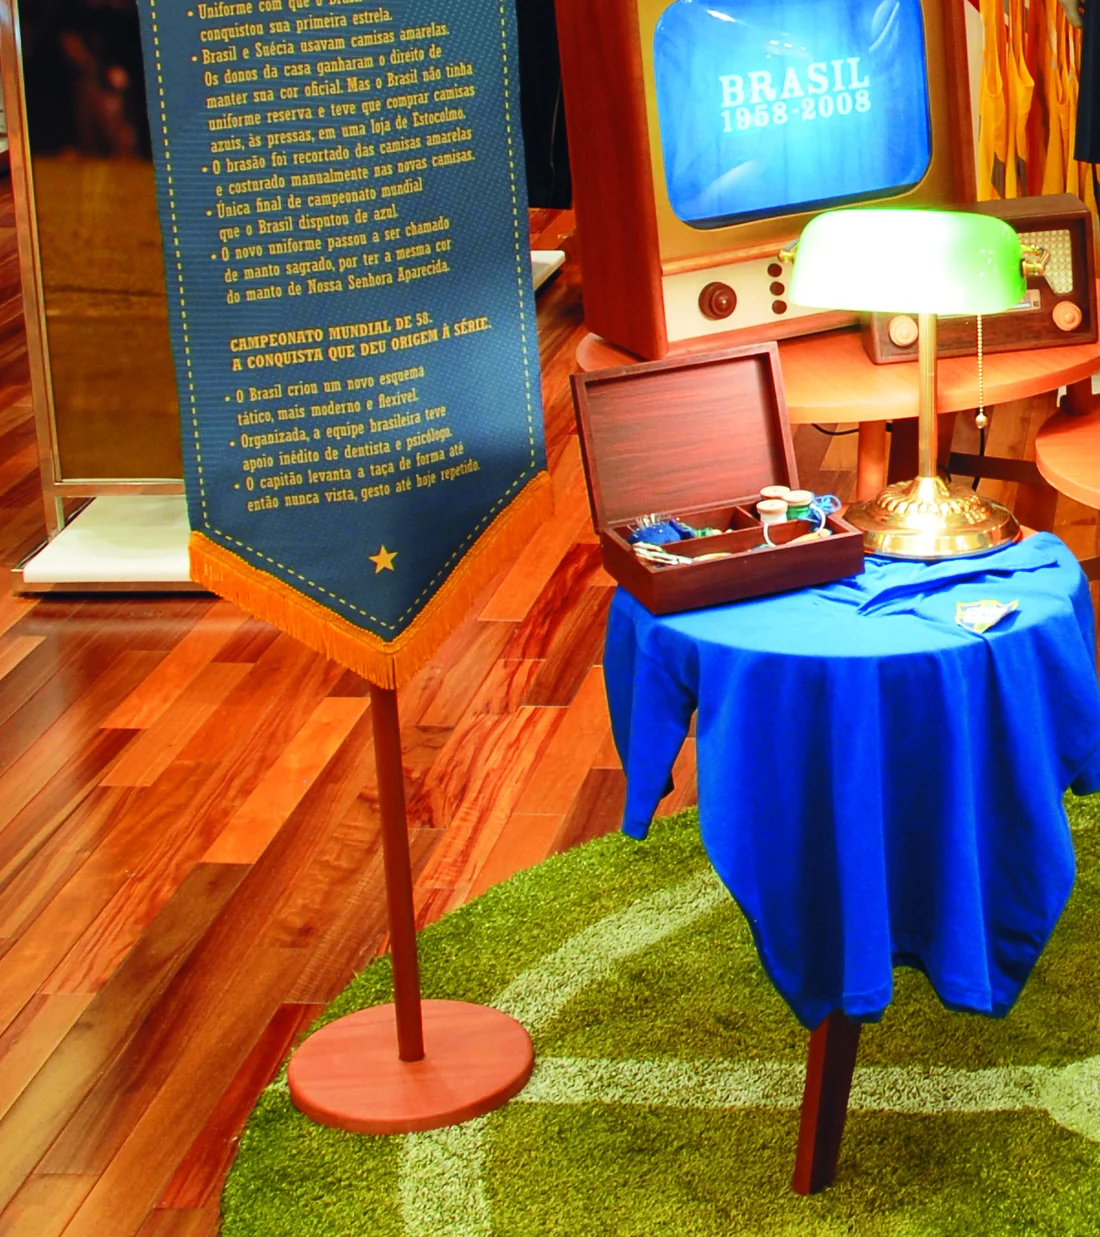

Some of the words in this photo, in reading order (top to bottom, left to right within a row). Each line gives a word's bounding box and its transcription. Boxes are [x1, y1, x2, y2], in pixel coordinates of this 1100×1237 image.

[197, 1, 252, 18] Uniforme
[200, 22, 263, 40] conquistou
[270, 21, 290, 32] sua
[296, 14, 346, 32] primeira
[202, 47, 236, 64] Brasil
[242, 48, 248, 58] e
[255, 40, 294, 56] Suécia
[300, 38, 344, 52] usavam
[351, 30, 394, 46] camisas
[204, 70, 218, 86] Os
[224, 70, 257, 82] donos
[263, 64, 278, 78] da
[284, 64, 310, 75] casa
[317, 57, 374, 74] ganharam
[378, 55, 384, 64] o
[391, 48, 424, 64] direito
[429, 45, 442, 58] de
[206, 93, 246, 108] manter
[254, 90, 274, 101] sua
[280, 87, 298, 98] cor
[347, 77, 370, 92] Mas
[376, 78, 382, 87] o
[386, 69, 417, 86] Brasil
[423, 67, 441, 80] não
[446, 60, 474, 76] tinha
[719, 57, 870, 108] BRASIL
[208, 112, 260, 130] uniforme
[267, 108, 312, 121] reserva
[318, 107, 324, 116] e
[330, 104, 356, 115] teve
[361, 100, 380, 114] que
[386, 93, 427, 108] comprar
[435, 84, 476, 100] camisas
[720, 89, 871, 132] 1958-2008
[212, 159, 221, 174] O
[226, 155, 264, 172] brasão
[271, 151, 286, 166] foi
[293, 147, 348, 162] recortado
[356, 144, 374, 156] das
[380, 136, 420, 153] camisas
[427, 128, 472, 146] amarelas
[216, 200, 250, 217] Única
[256, 197, 280, 212] final
[287, 195, 300, 208] de
[308, 188, 376, 206] campeonato
[381, 178, 423, 196] mundial
[218, 227, 239, 242] que
[246, 225, 252, 234] o
[258, 216, 291, 234] Brasil
[298, 213, 348, 230] disputou
[354, 210, 368, 222] de
[220, 246, 230, 261] O
[235, 246, 262, 258] novo
[269, 237, 320, 254] uniforme
[328, 234, 366, 250] passou
[373, 232, 379, 241] a
[384, 228, 400, 239] ser
[406, 216, 450, 236] chamado
[226, 290, 240, 304] do
[246, 286, 282, 300] manto
[288, 282, 301, 295] de
[308, 278, 342, 292] Nossa
[348, 273, 392, 289] Senhora
[229, 328, 324, 352] CAMPEONATO
[328, 320, 390, 338] MUNDIAL
[395, 315, 410, 329] DE
[232, 358, 242, 371] A
[246, 348, 323, 368] CONQUISTA
[328, 344, 354, 360] QUE
[360, 340, 385, 356] DEU
[390, 328, 438, 349] ORIGEM
[235, 389, 244, 402] O
[248, 384, 282, 400] Brasil
[287, 382, 318, 395] criou
[324, 380, 341, 392] um
[347, 376, 374, 390] novo
[380, 367, 424, 384] esquema
[278, 406, 305, 419] mais
[311, 401, 360, 416] moderno
[366, 400, 372, 408] e
[314, 429, 320, 438] a
[326, 422, 364, 438] equipe
[370, 412, 420, 431] brasileira
[425, 406, 446, 418] teve
[245, 476, 254, 490] O
[260, 472, 302, 488] capitão
[308, 469, 351, 482] levanta
[358, 468, 364, 476] a
[370, 463, 394, 475] taça
[400, 458, 410, 470] de
[416, 452, 444, 464] forma
[450, 442, 464, 456] até
[247, 495, 278, 511] então
[284, 494, 319, 506] nunca
[361, 484, 390, 500] gesto
[396, 478, 411, 492] até
[416, 472, 436, 486] hoje
